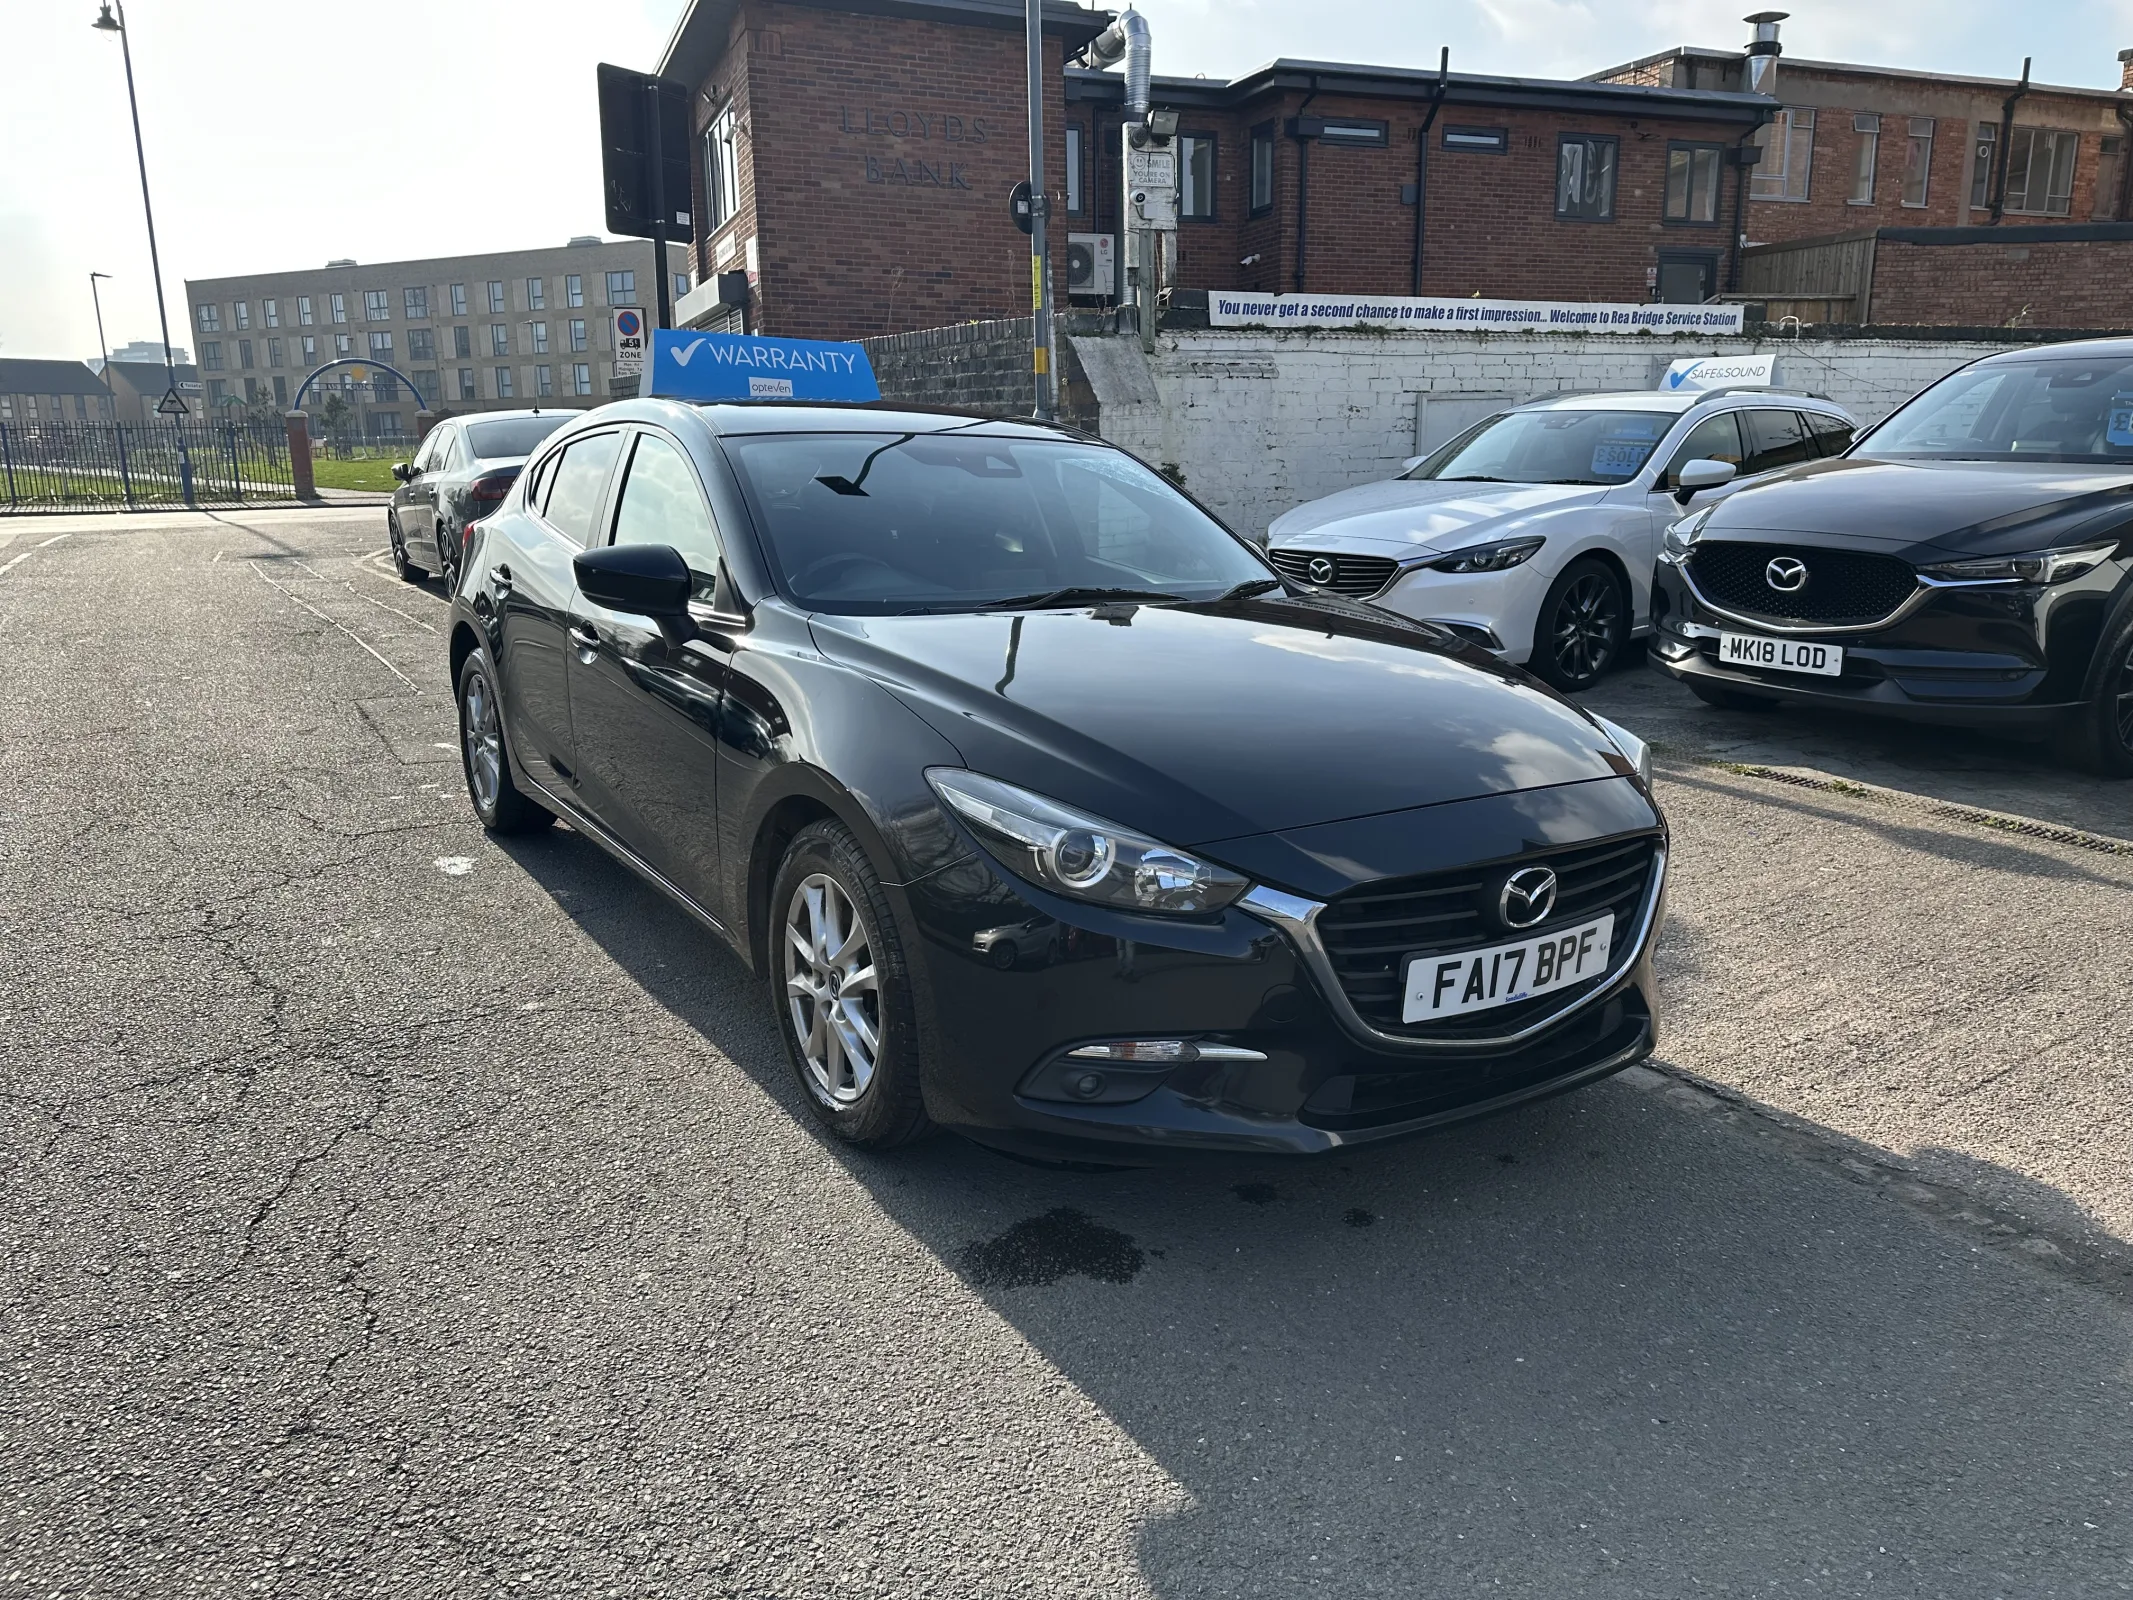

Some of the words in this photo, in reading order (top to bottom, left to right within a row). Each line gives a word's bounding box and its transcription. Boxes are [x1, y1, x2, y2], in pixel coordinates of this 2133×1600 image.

[841, 105, 988, 143] LLOYDS
[865, 155, 974, 191] BANK
[1147, 159, 1170, 168] SMILE
[1218, 299, 1241, 315] You
[1242, 302, 1278, 316] never
[1278, 302, 1299, 318] get
[1301, 305, 1309, 317] a
[1310, 303, 1354, 318] second
[1355, 303, 1398, 319] chance
[1400, 305, 1411, 319] to
[1413, 305, 1445, 320] make
[1446, 308, 1454, 320] a
[1455, 306, 1480, 321] first
[1480, 306, 1548, 323] impression...
[1549, 309, 1597, 324] Welcome
[1599, 311, 1610, 324] to
[1611, 311, 1629, 325] Rea
[1631, 311, 1664, 326] Bridge
[1665, 311, 1701, 325] Service
[1702, 312, 1737, 326] Station
[708, 342, 856, 374] WARRANTY
[751, 381, 792, 394] opteven
[1690, 366, 1766, 380] SAFE&SOUND
[1607, 450, 1646, 464] SOLD
[1730, 637, 1775, 663] MK18
[1781, 643, 1826, 669] LOD
[1432, 947, 1527, 1009] FA17
[1532, 926, 1598, 988] BPF
